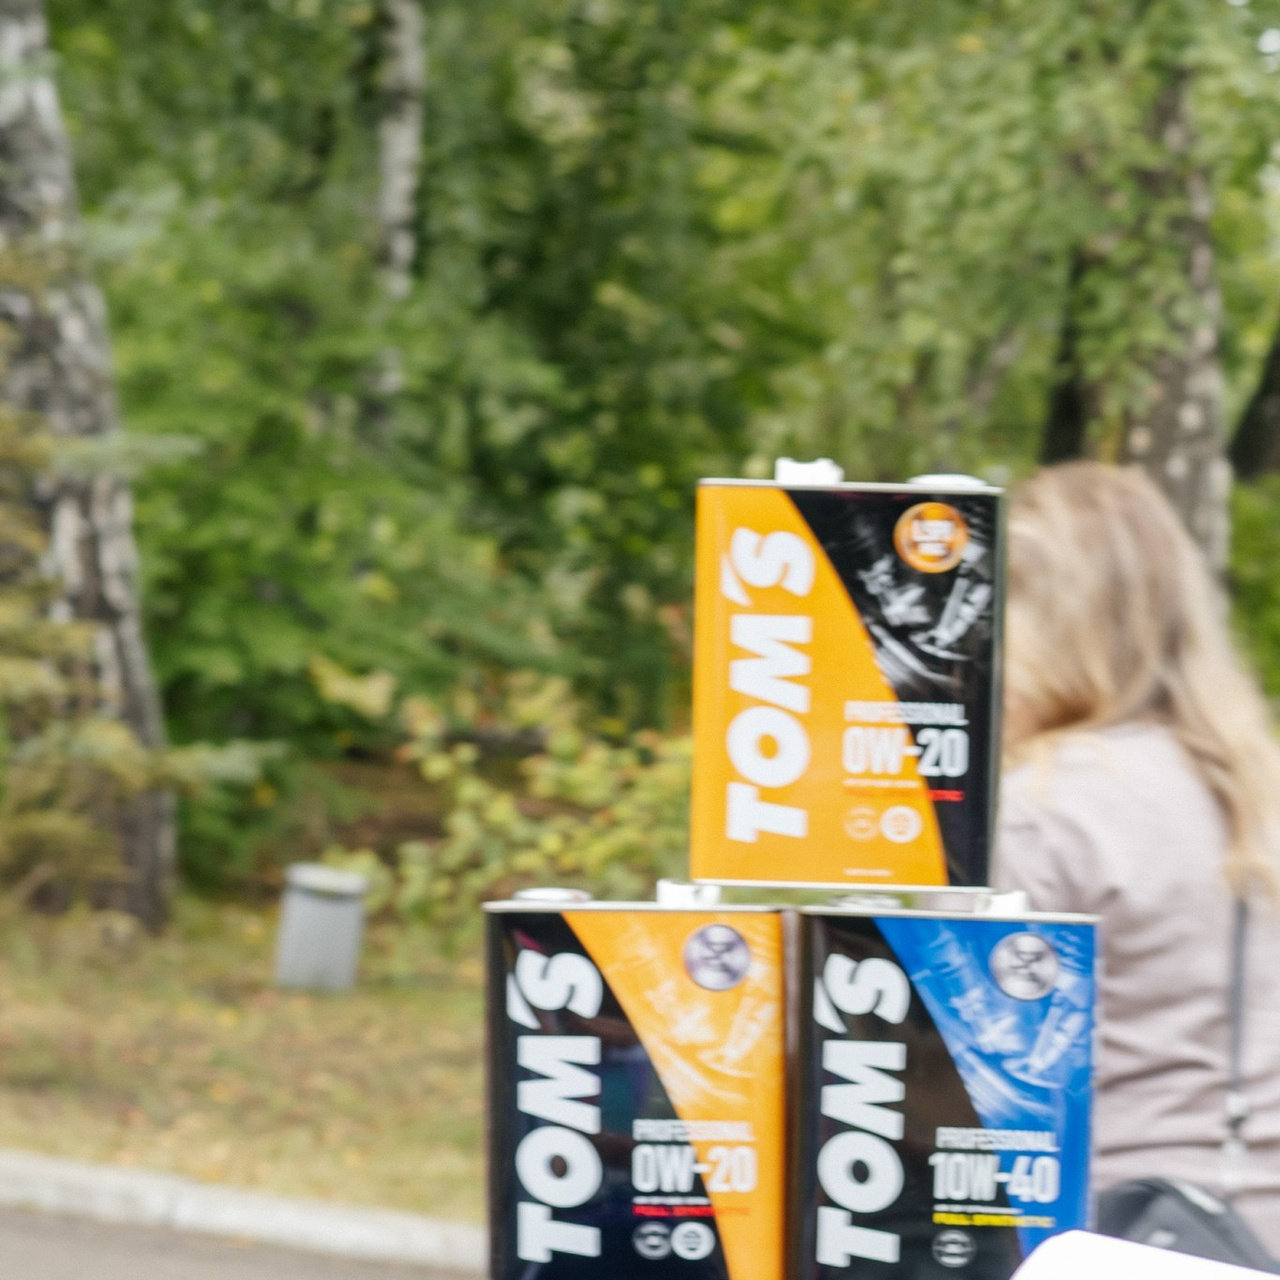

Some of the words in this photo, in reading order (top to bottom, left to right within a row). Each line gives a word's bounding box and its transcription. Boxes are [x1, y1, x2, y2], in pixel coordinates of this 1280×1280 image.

[721, 527, 815, 843] TOM'S
[842, 726, 970, 778] 0W-20
[506, 949, 604, 1264] TOM'S
[631, 1143, 758, 1194] 0W-20
[813, 953, 911, 1269] TOM'S
[928, 1152, 1060, 1204] 10W-40
